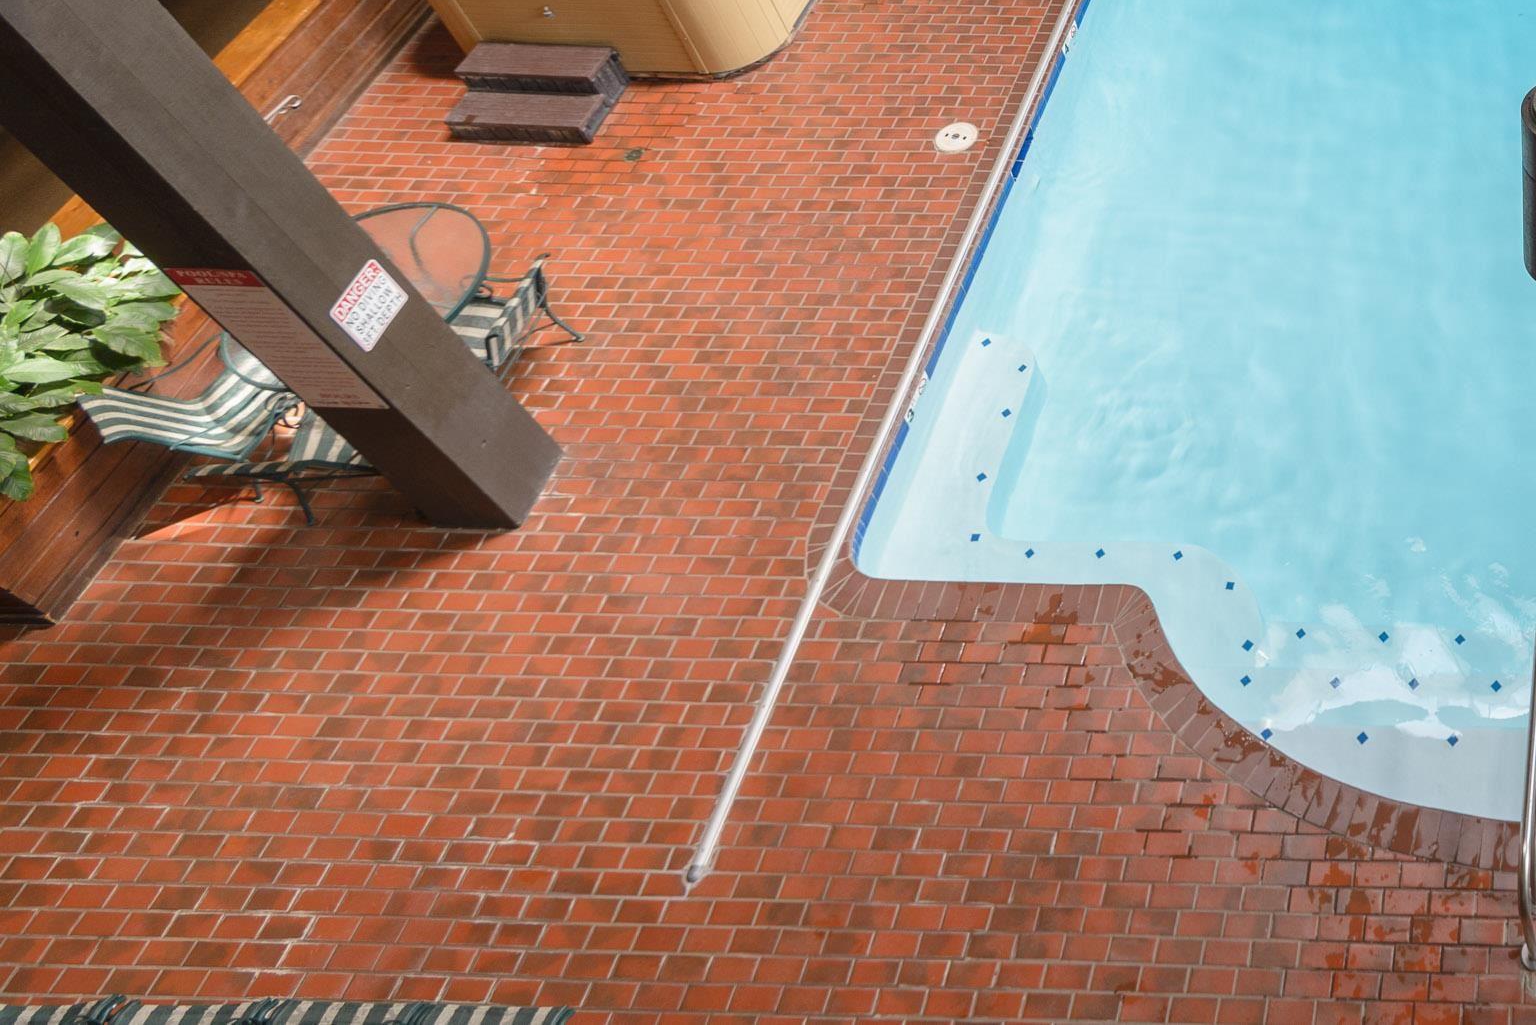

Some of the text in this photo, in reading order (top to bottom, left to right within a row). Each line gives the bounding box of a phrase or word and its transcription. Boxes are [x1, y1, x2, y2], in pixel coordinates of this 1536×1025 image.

[344, 273, 388, 328] NO DIVING
[354, 284, 394, 335] SHALLOW
[375, 291, 404, 327] DEPTH
